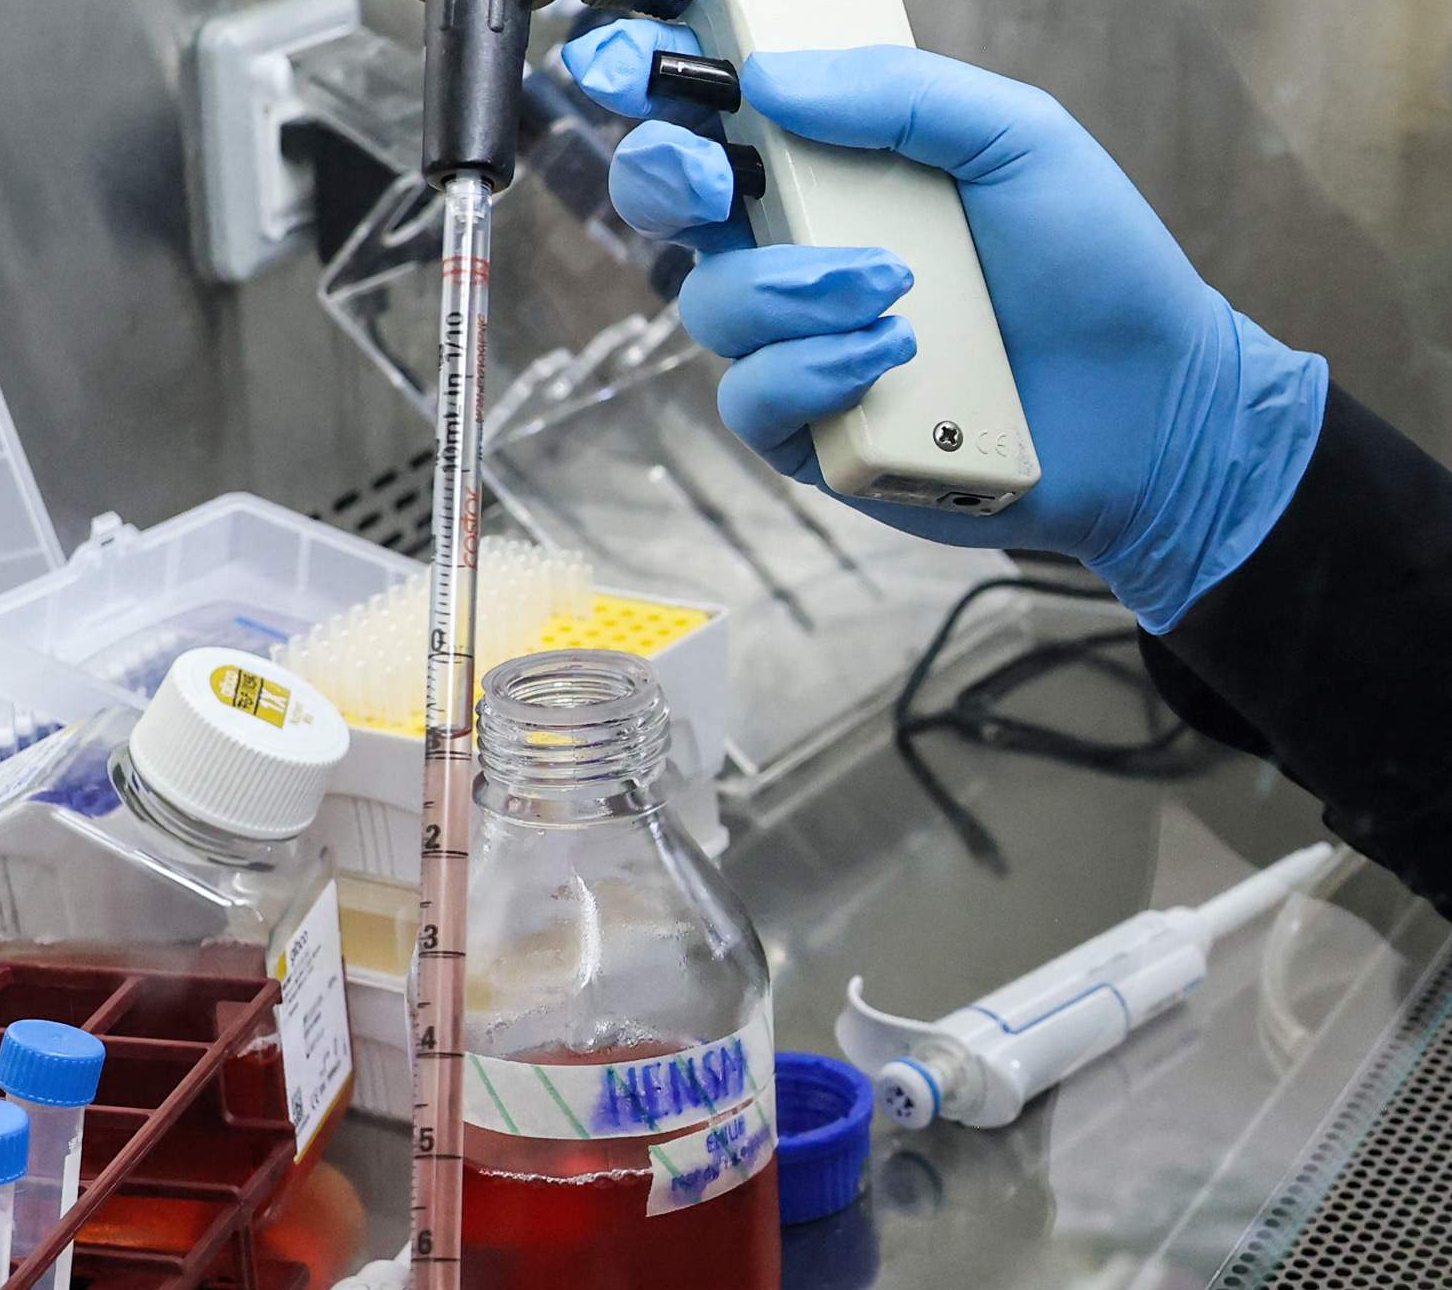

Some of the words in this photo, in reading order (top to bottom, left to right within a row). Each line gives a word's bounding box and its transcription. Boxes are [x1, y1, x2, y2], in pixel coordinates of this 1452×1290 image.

[445, 311, 463, 362] 1/10
[431, 628, 443, 652] 0
[425, 824, 441, 849] 2
[423, 924, 439, 950] 3
[421, 1026, 437, 1050] 4
[419, 1127, 435, 1152] 5
[418, 1230, 433, 1255] 6
